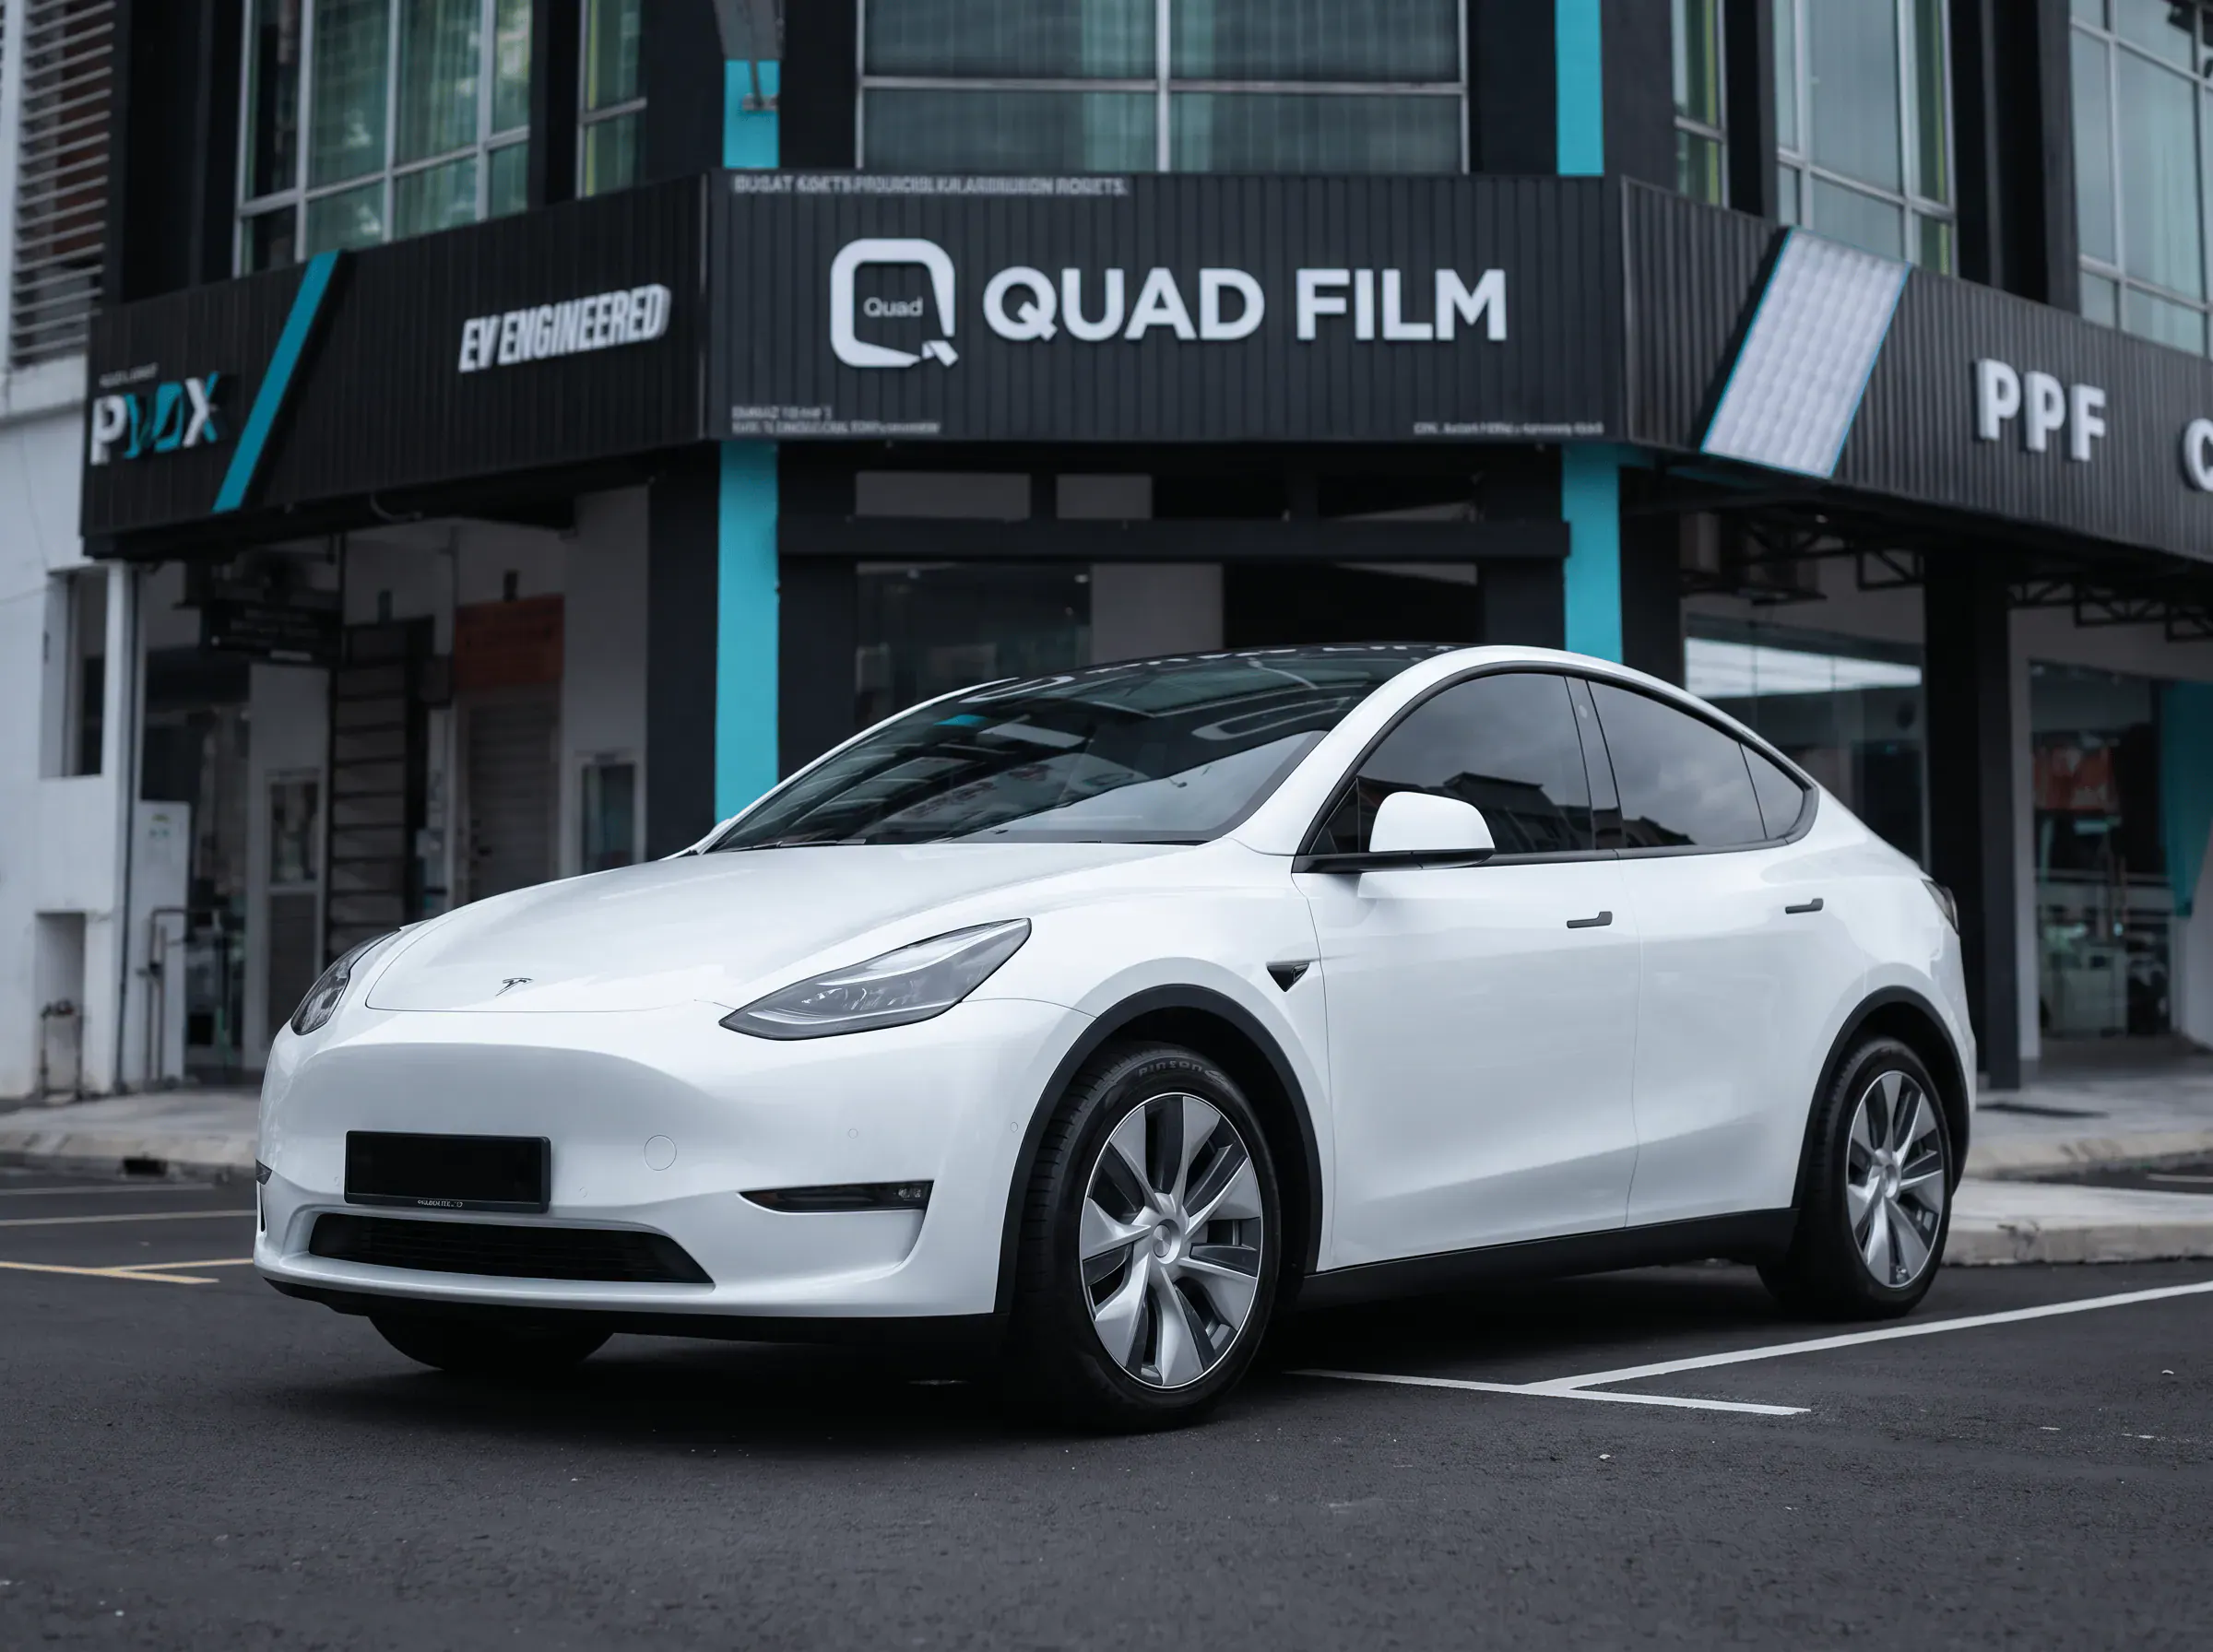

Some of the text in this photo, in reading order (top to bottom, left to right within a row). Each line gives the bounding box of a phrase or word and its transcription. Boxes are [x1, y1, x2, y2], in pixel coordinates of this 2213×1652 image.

[458, 283, 671, 372] EV ENGINEERED
[863, 296, 924, 318] Quad
[983, 266, 1508, 342] QUAD FILM
[1976, 358, 2106, 462] PPF
